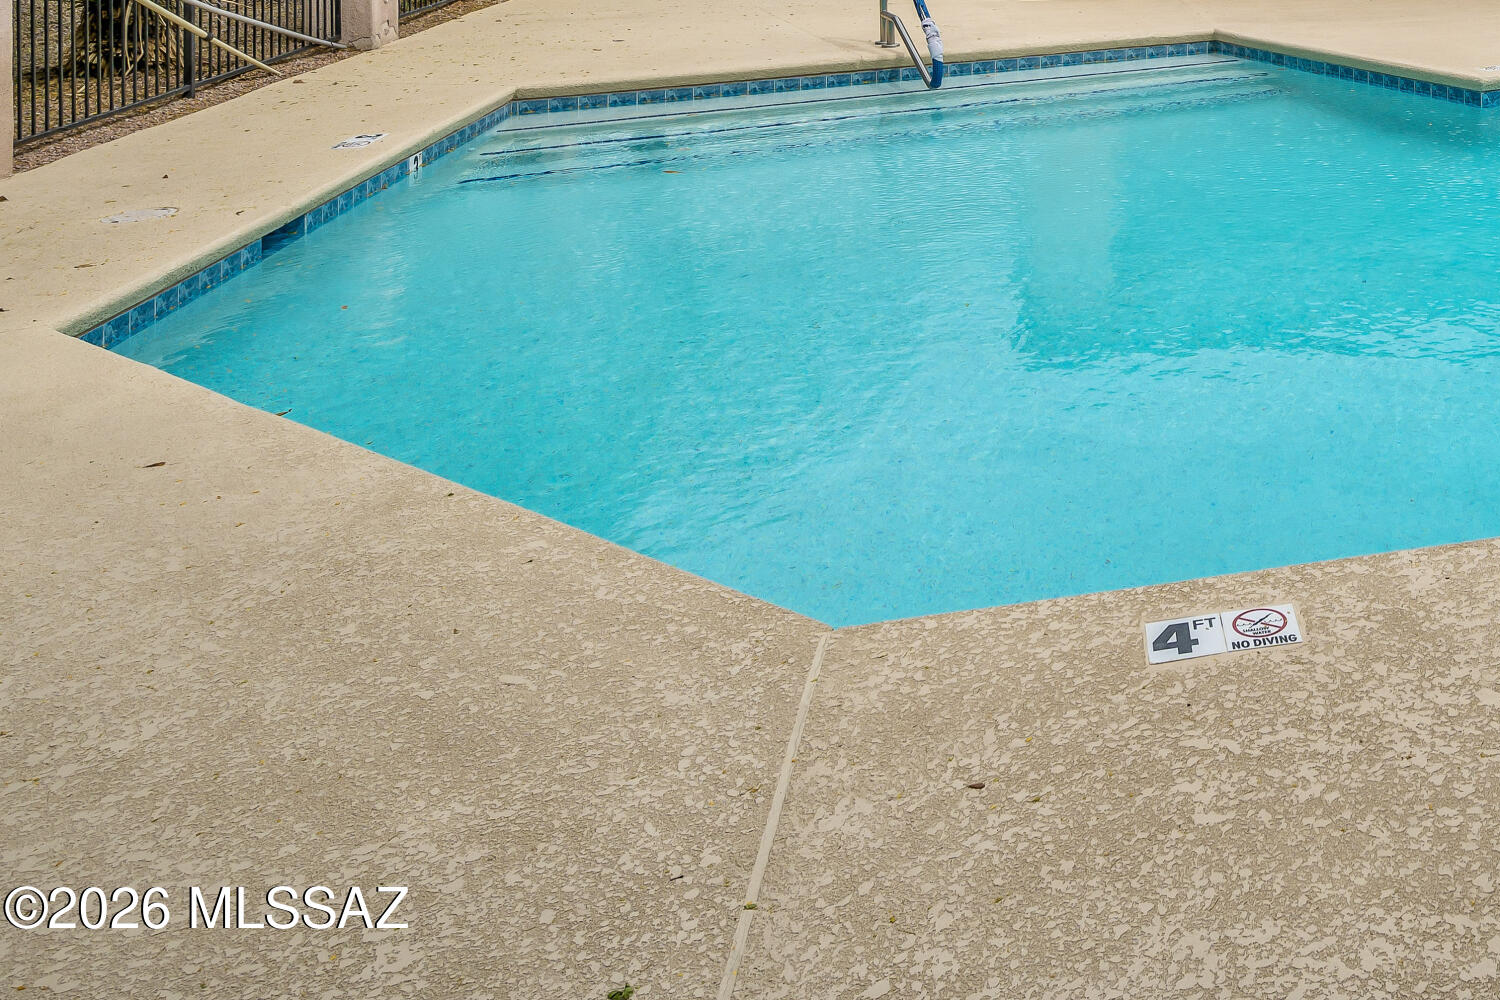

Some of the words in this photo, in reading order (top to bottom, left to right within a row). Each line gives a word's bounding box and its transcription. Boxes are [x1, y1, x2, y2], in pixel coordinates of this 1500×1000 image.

[1152, 621, 1199, 655] 4
[1193, 617, 1216, 630] FT
[1231, 640, 1251, 650] NO
[1252, 634, 1298, 647] DIVING
